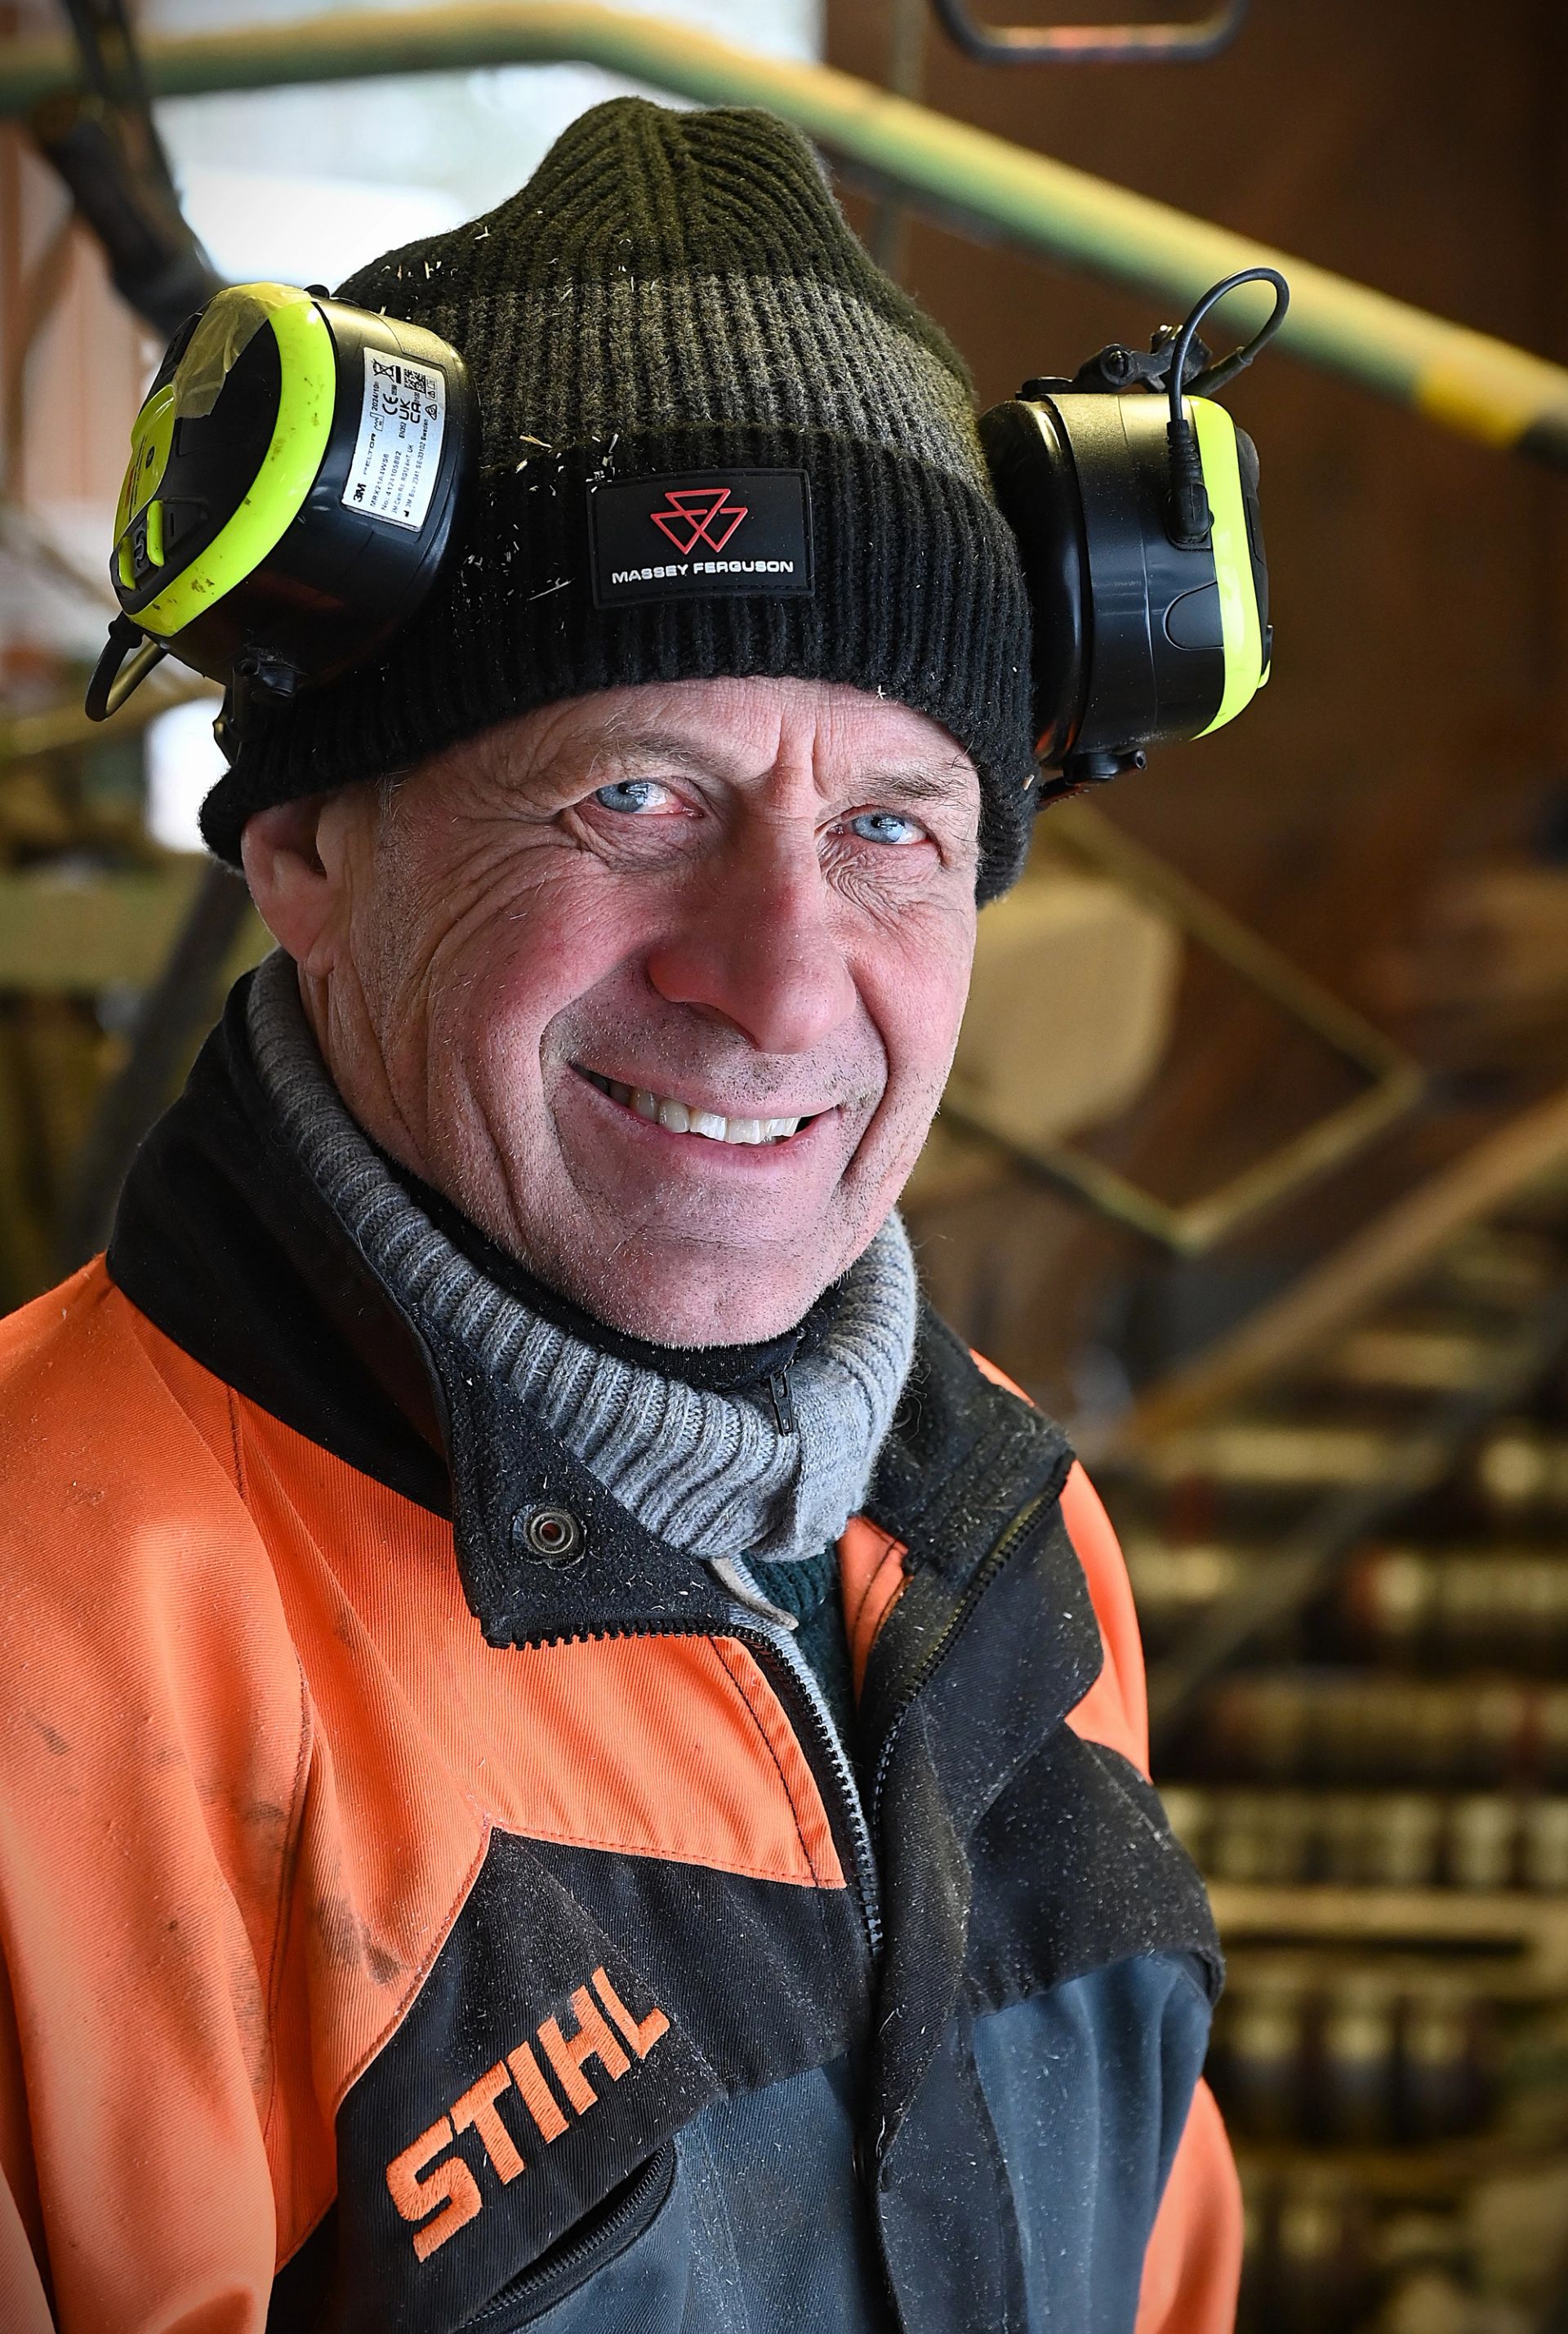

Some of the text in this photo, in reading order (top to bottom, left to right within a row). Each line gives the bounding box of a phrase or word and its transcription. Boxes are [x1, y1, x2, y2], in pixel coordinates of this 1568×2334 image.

[382, 393, 399, 415] CE
[399, 398, 411, 421] UK
[410, 402, 421, 424] CA
[353, 483, 367, 502] 3M
[612, 560, 794, 584] MASSEY FERGUSON
[385, 1966, 670, 2264] STIHL
